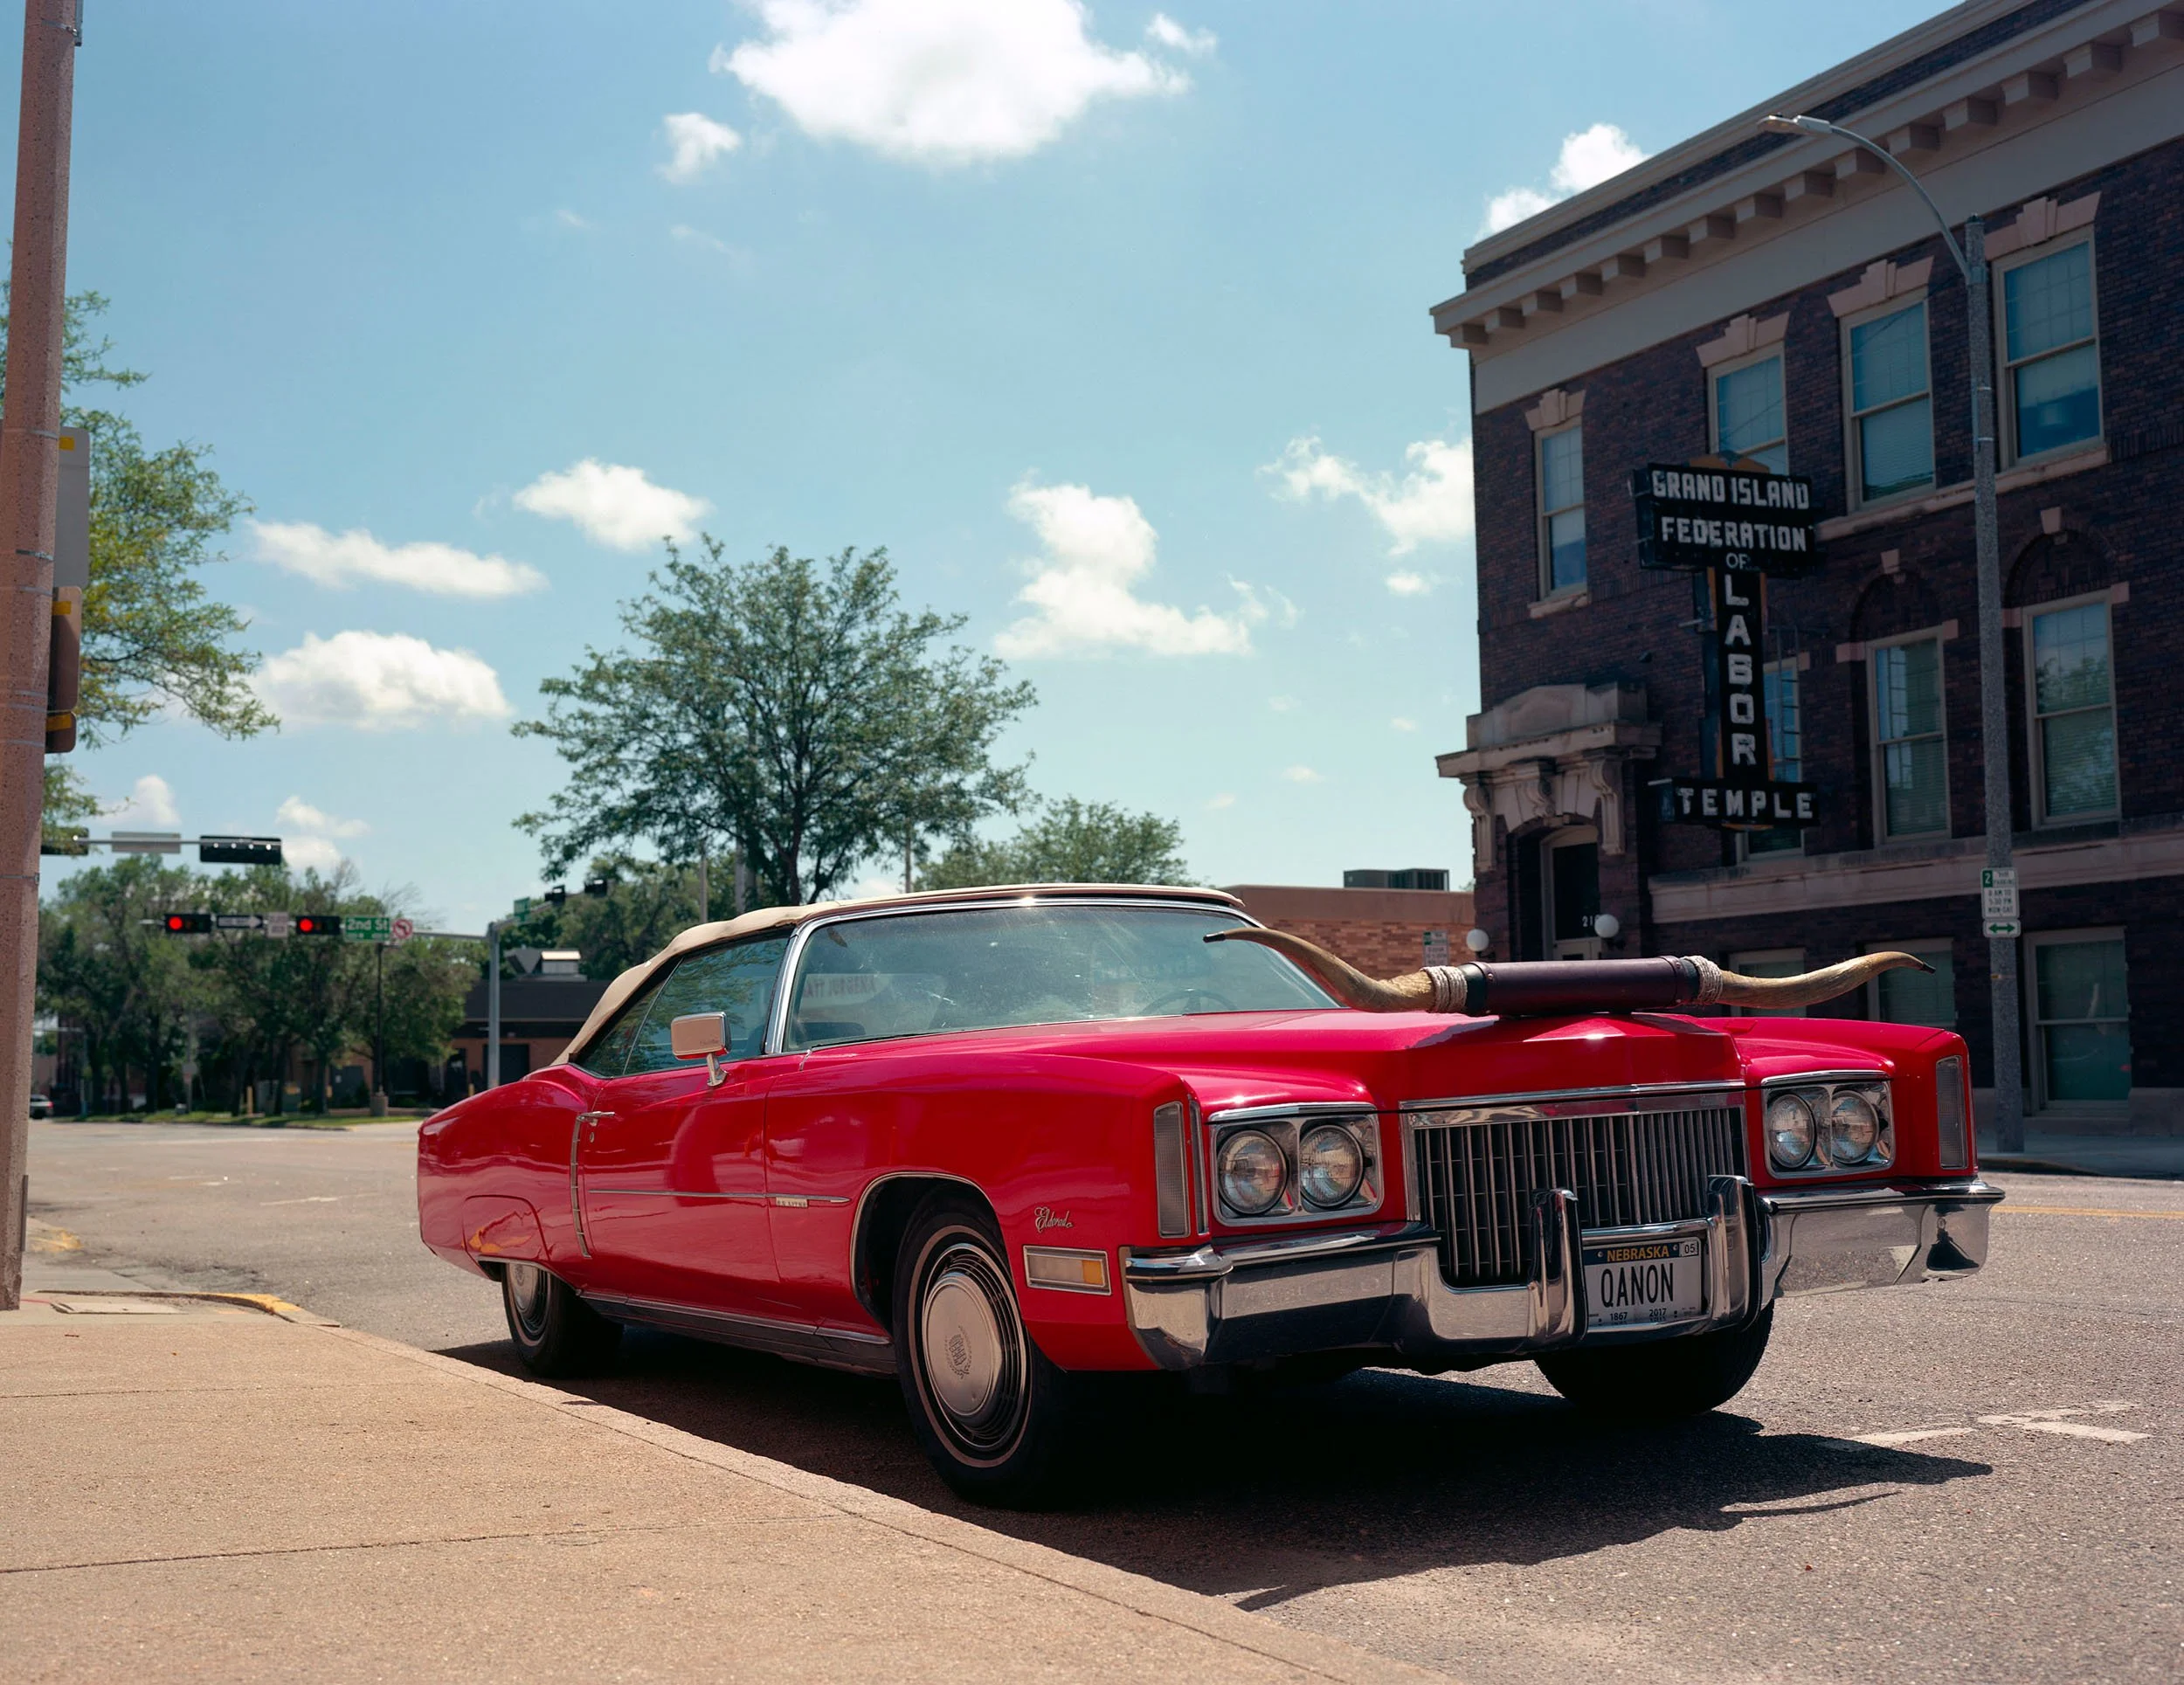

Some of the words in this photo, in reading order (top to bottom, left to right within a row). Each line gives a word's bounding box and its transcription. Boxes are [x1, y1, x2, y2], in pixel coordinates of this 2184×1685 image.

[1651, 470, 1725, 503] GRAND
[1731, 477, 1809, 509] ISLAND
[1661, 516, 1807, 552] FEDERATION
[1725, 552, 1749, 570] OF
[1724, 574, 1756, 765] LABOR
[1677, 787, 1813, 819] TEMPLE
[1984, 873, 1992, 884] 2
[348, 919, 372, 931] 2nd
[376, 919, 388, 931] St
[1034, 1206, 1074, 1233] Eldorado
[1607, 1245, 1669, 1262] NEBRASKA
[1684, 1243, 1696, 1254] 05
[1600, 1262, 1674, 1308] QANON
[1610, 1311, 1628, 1322] 1867
[1648, 1308, 1667, 1318] 2017
